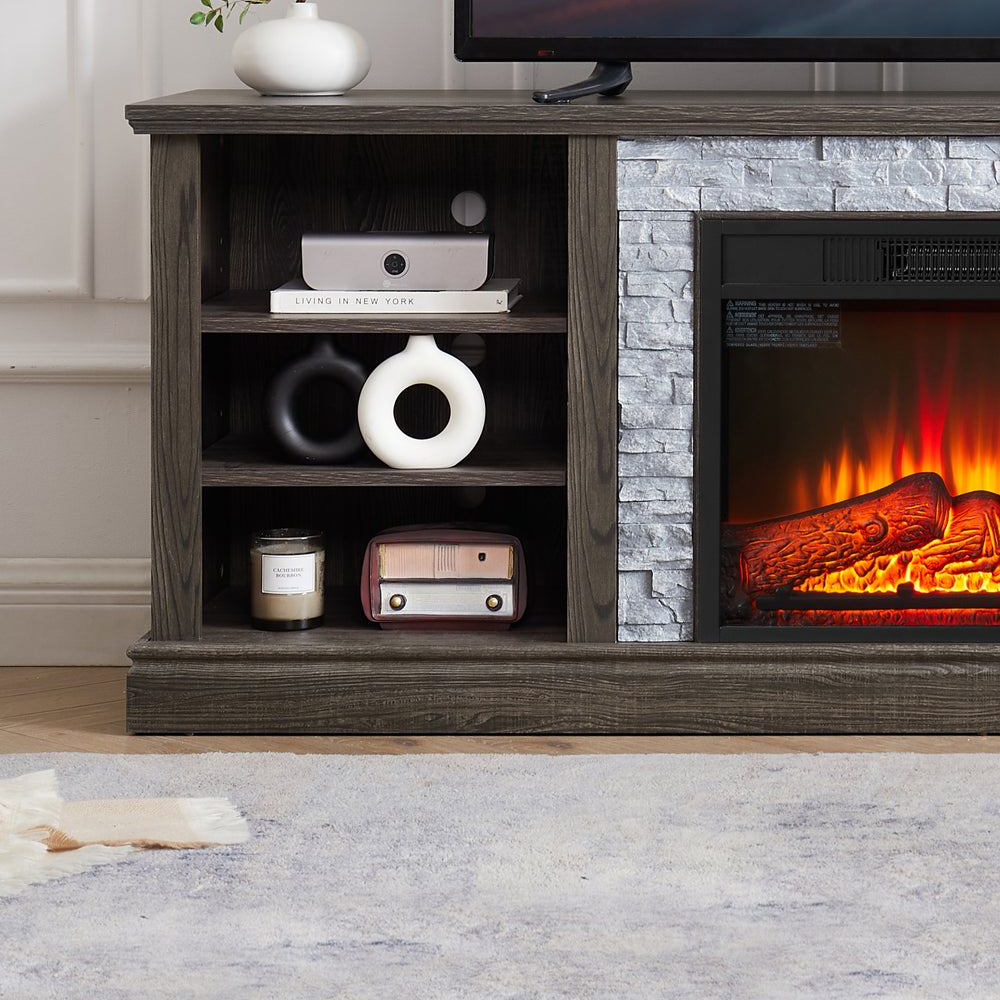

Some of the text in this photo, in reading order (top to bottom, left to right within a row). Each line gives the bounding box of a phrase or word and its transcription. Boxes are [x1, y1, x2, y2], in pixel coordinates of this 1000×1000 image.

[295, 297, 415, 305] LIVING IN NEW YORK
